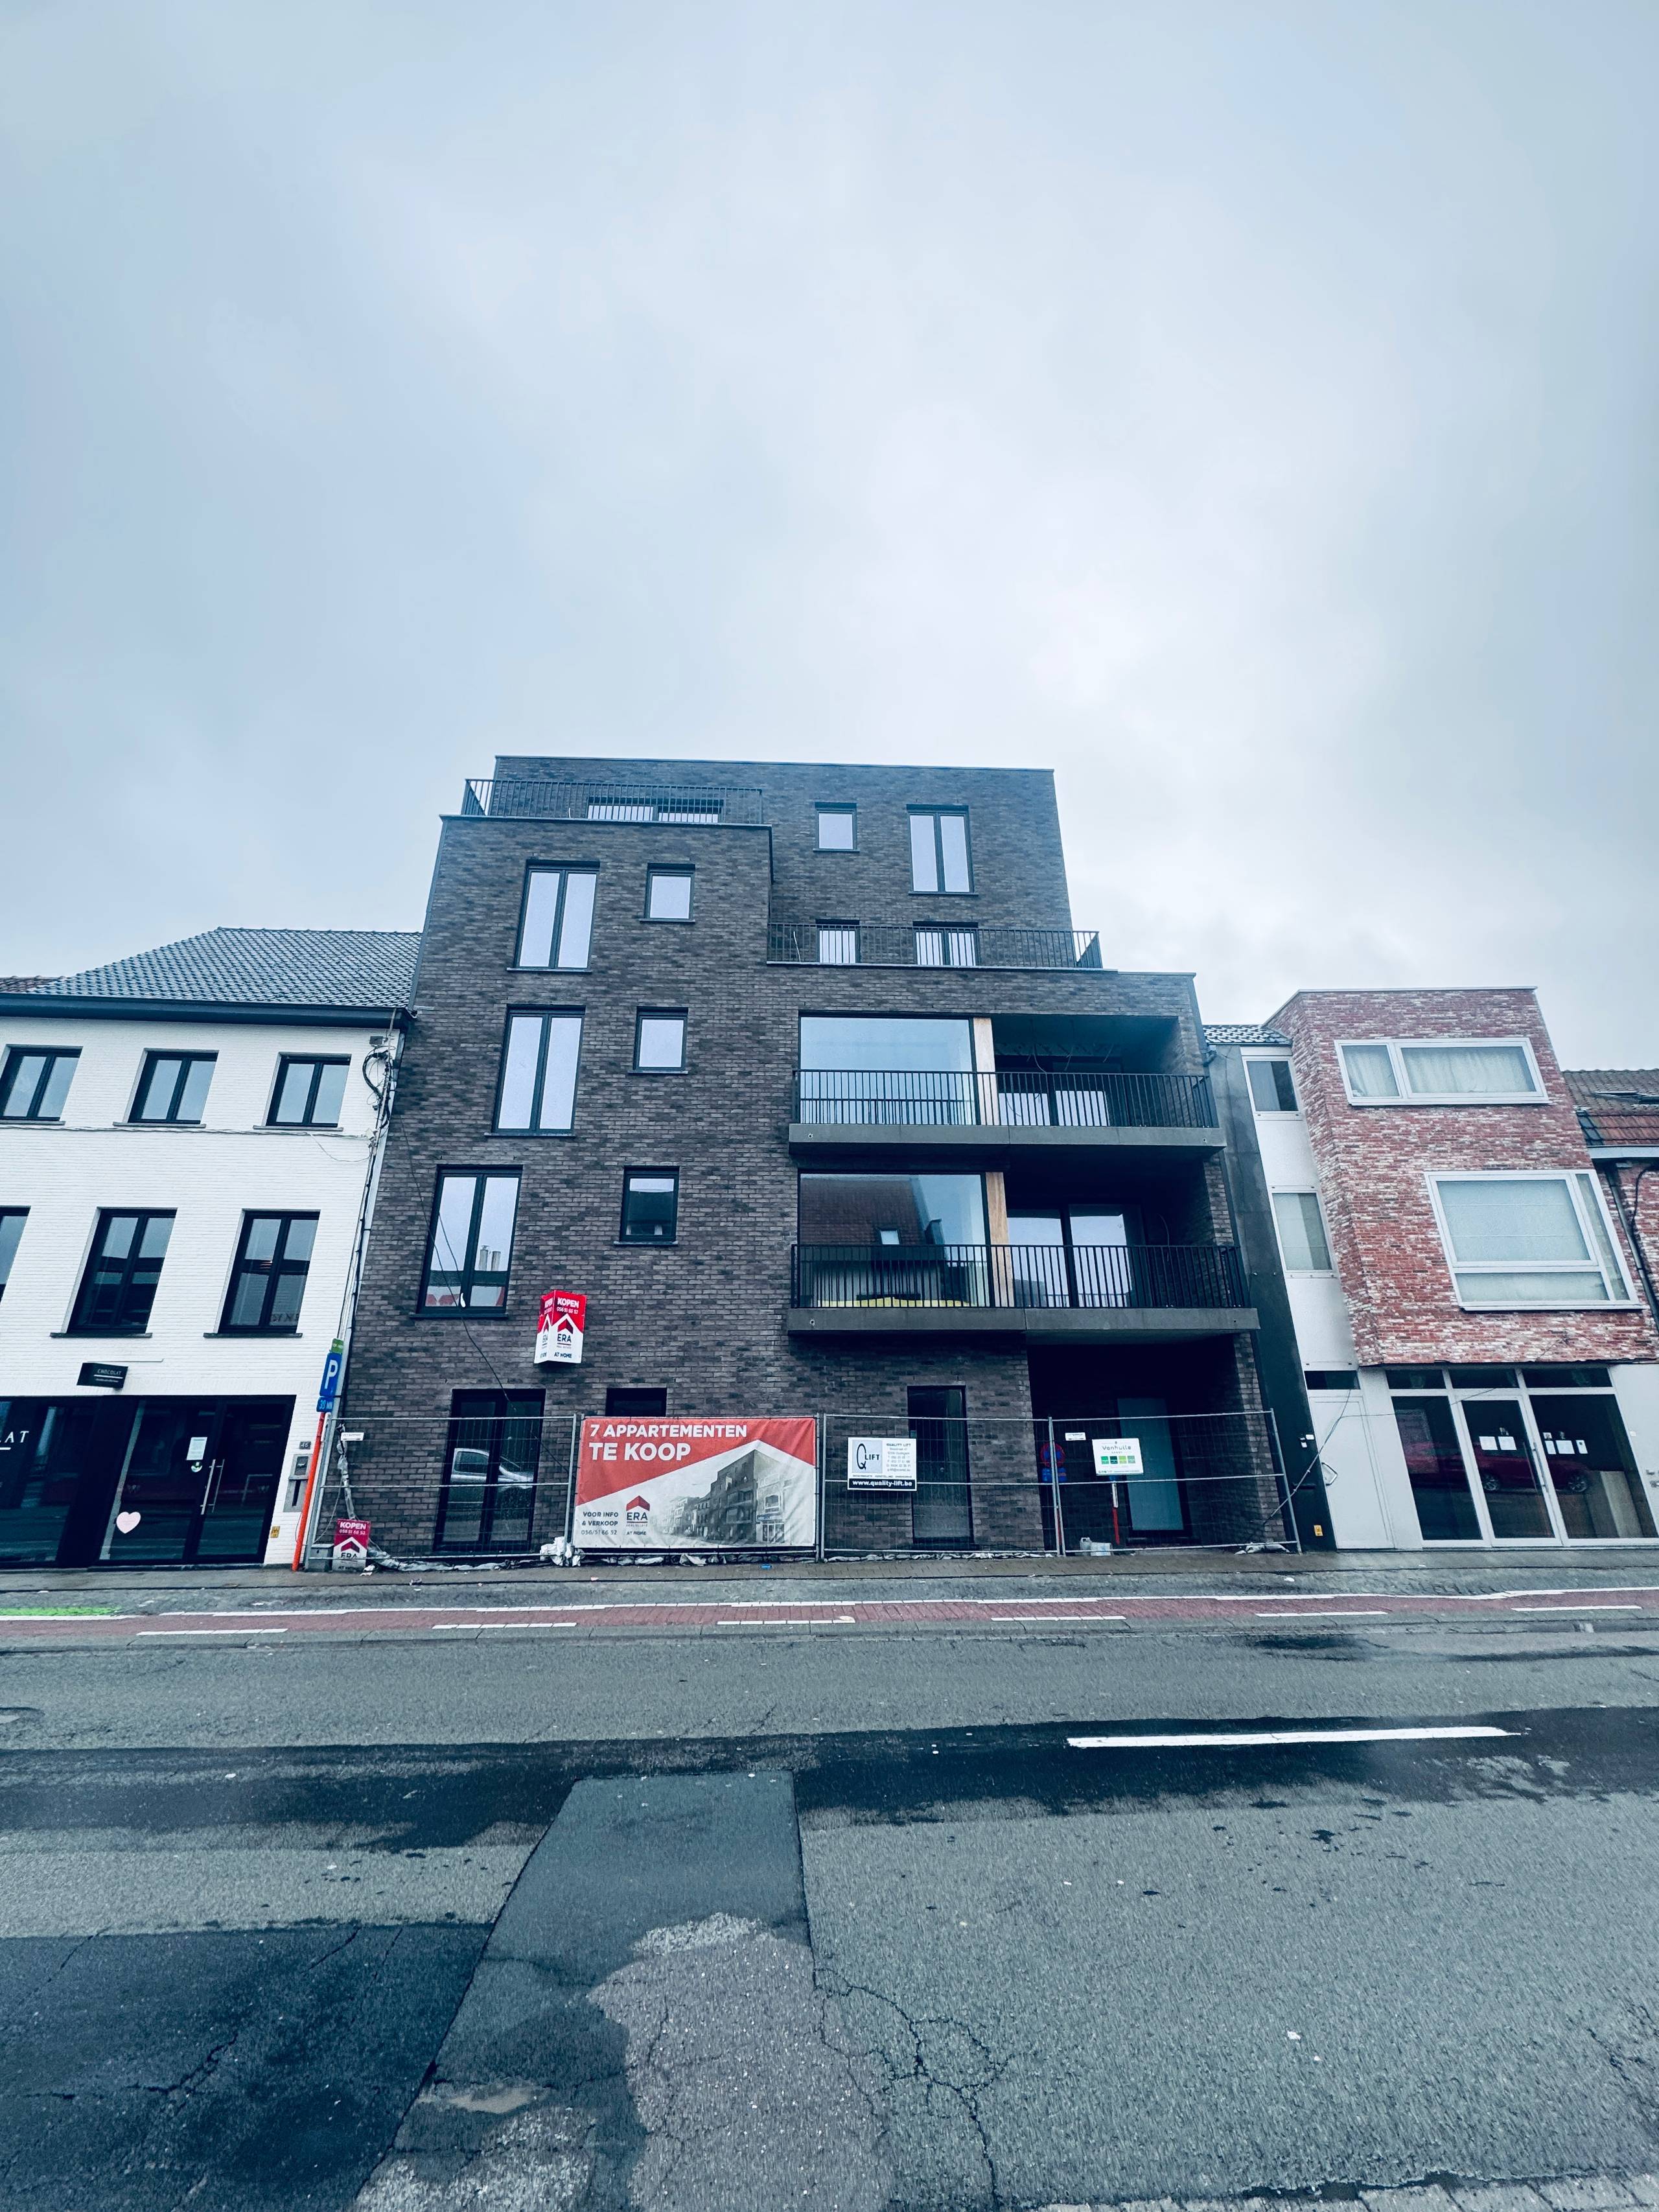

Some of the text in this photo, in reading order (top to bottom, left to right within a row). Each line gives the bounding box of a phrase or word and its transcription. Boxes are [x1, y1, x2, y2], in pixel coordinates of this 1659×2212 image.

[557, 1297, 579, 1308] KOPEN
[557, 1334, 572, 1343] ERA
[325, 1359, 338, 1390] P
[0, 1430, 29, 1443] AT
[590, 1425, 747, 1438] 7 APPARTEMENTEN
[588, 1442, 691, 1461] TE KOOP
[626, 1512, 648, 1520] ERA
